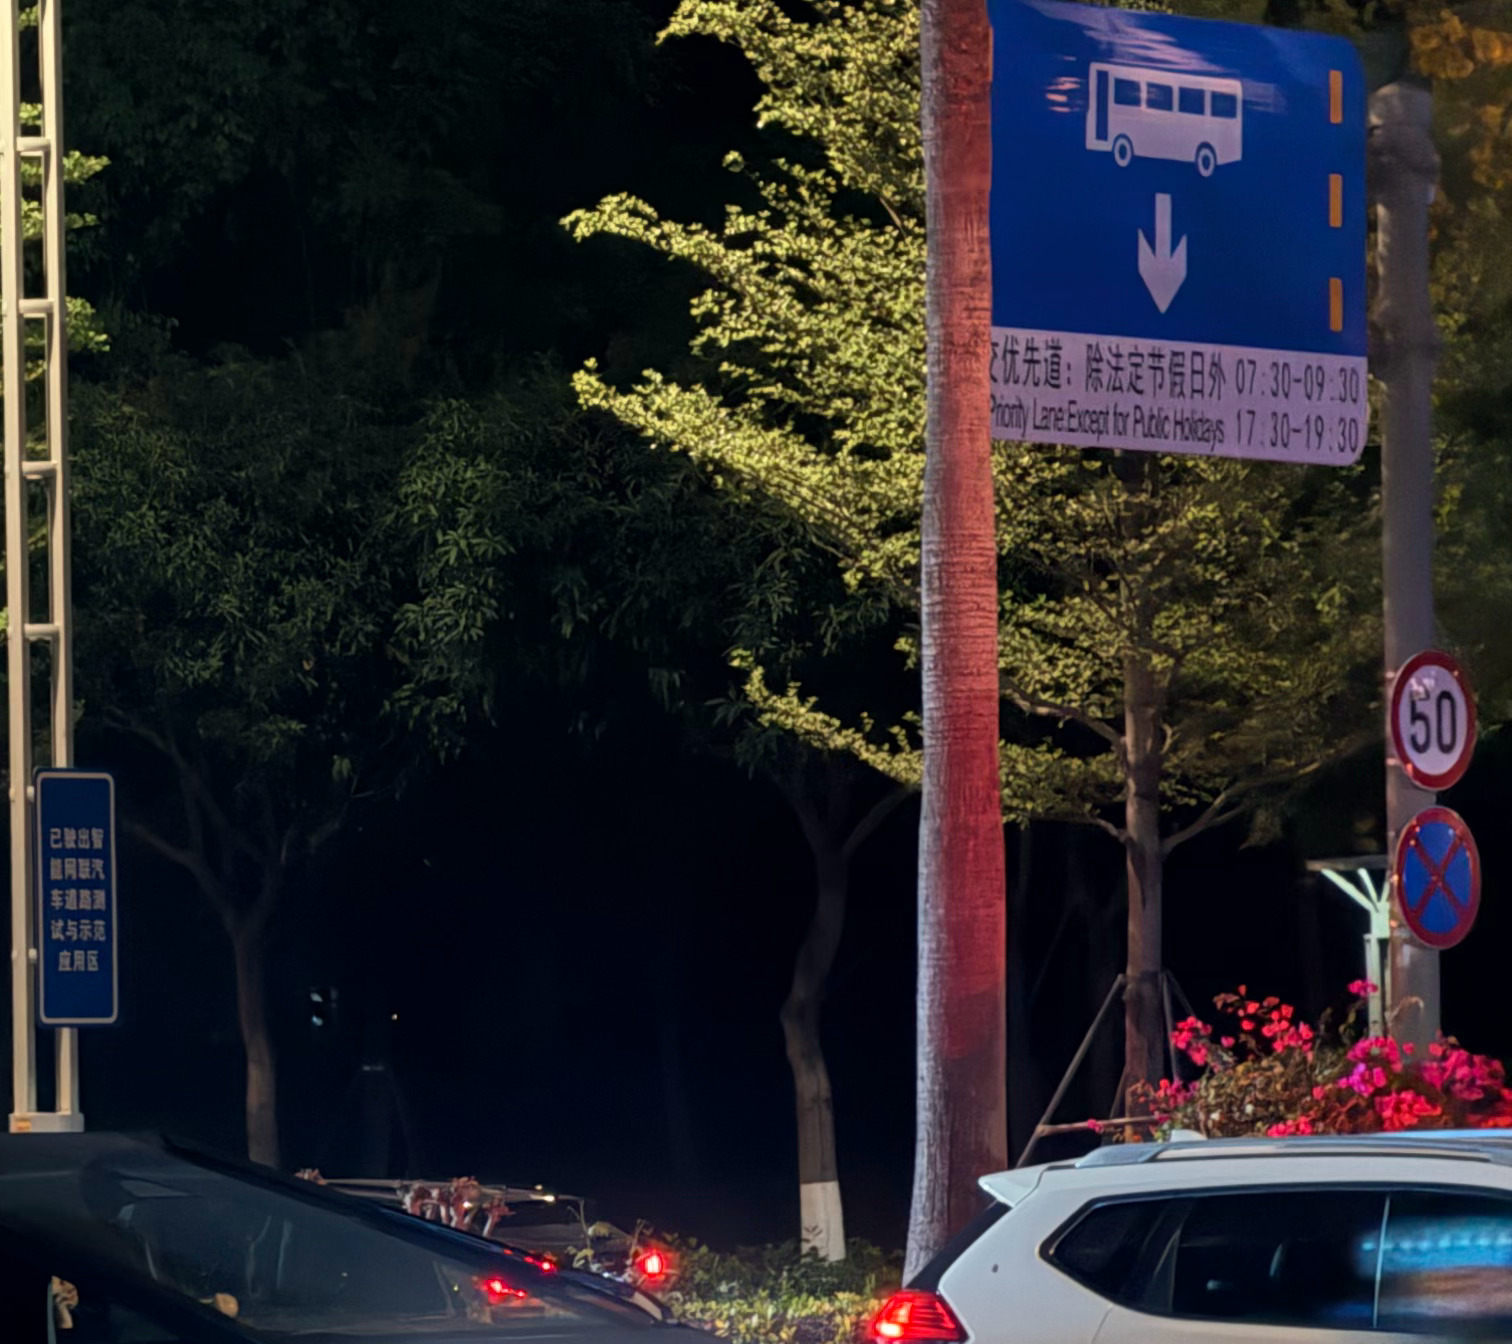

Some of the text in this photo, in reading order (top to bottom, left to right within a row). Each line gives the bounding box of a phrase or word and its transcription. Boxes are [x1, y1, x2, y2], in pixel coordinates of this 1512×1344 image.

[1113, 401, 1130, 436] for
[1133, 404, 1171, 441] Public
[1173, 408, 1225, 452] Holidays
[1410, 689, 1458, 755] 50
[50, 919, 107, 942] 试与示范
[57, 949, 100, 972] 应用区
